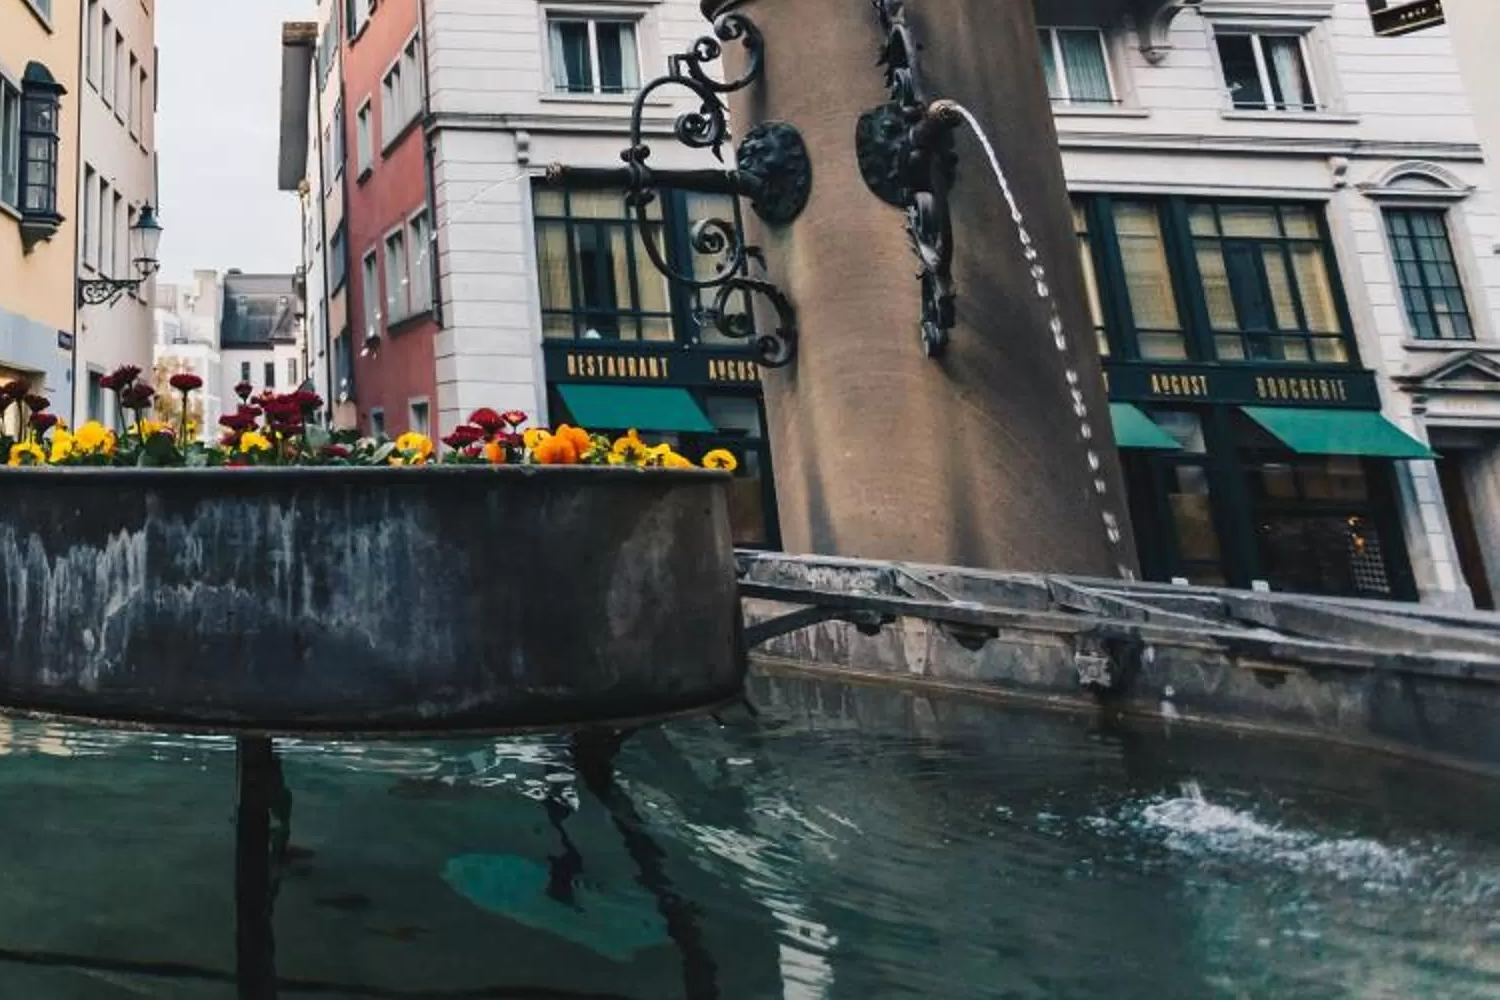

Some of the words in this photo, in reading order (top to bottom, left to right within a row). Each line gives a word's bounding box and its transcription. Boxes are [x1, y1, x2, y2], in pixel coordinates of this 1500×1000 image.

[567, 354, 668, 378] RESTAURANT
[1151, 373, 1207, 396] AUGUST
[1255, 376, 1347, 401] BOUCHERIE
